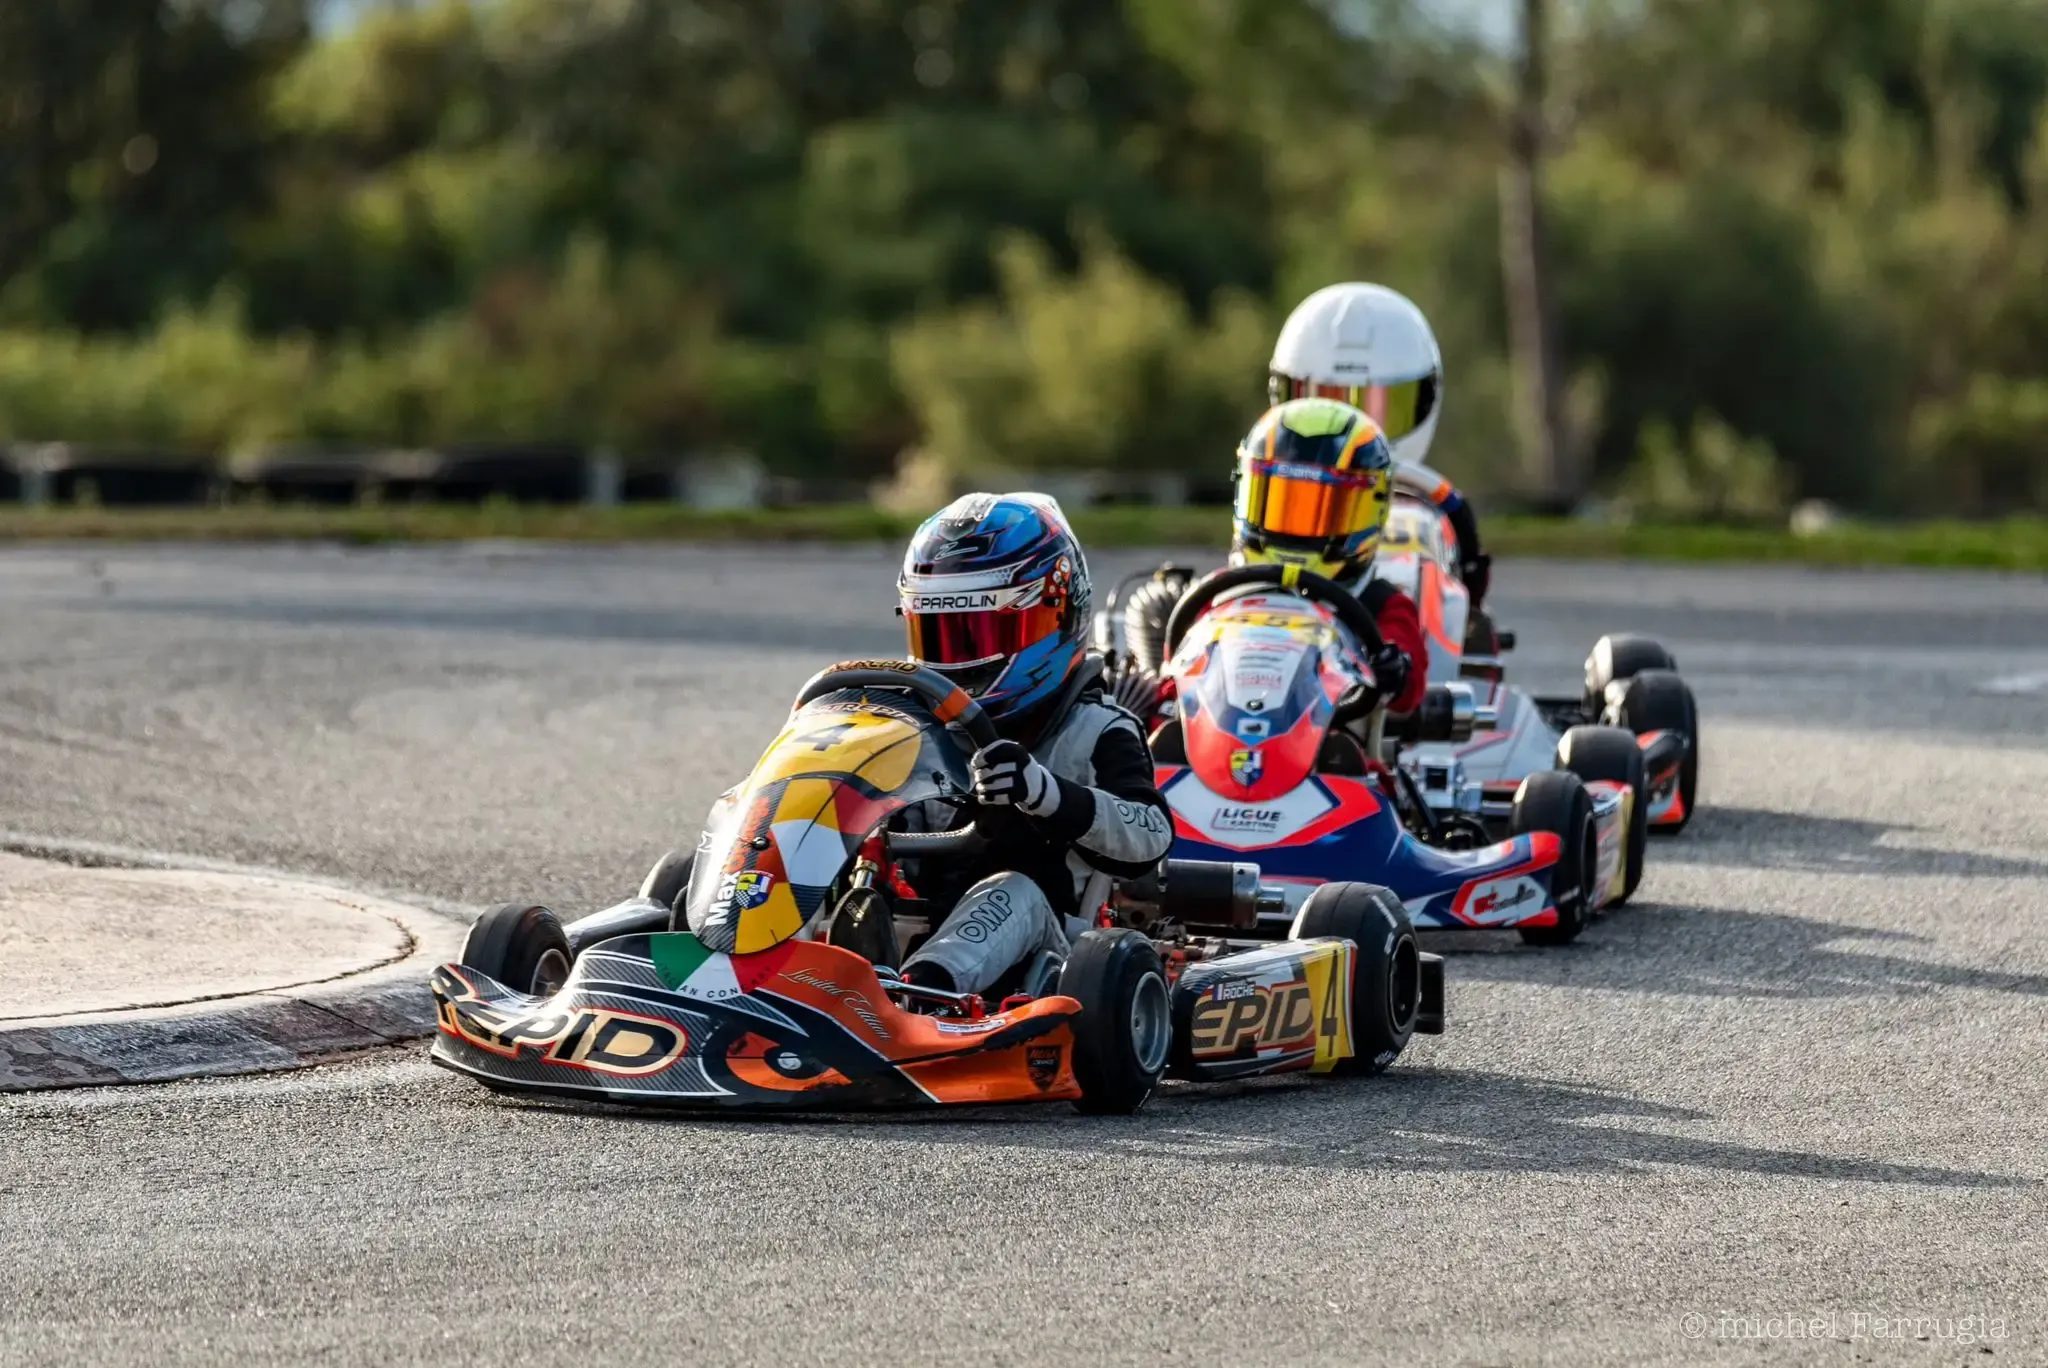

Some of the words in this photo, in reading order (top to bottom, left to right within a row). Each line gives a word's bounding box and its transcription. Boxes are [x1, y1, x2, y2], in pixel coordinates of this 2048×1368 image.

[920, 595, 997, 610] PAROLIN
[793, 722, 858, 751] 4
[955, 888, 1013, 944] OMP
[777, 967, 843, 996] Limited
[843, 996, 891, 1040] Edition
[1319, 948, 1341, 1058] 4
